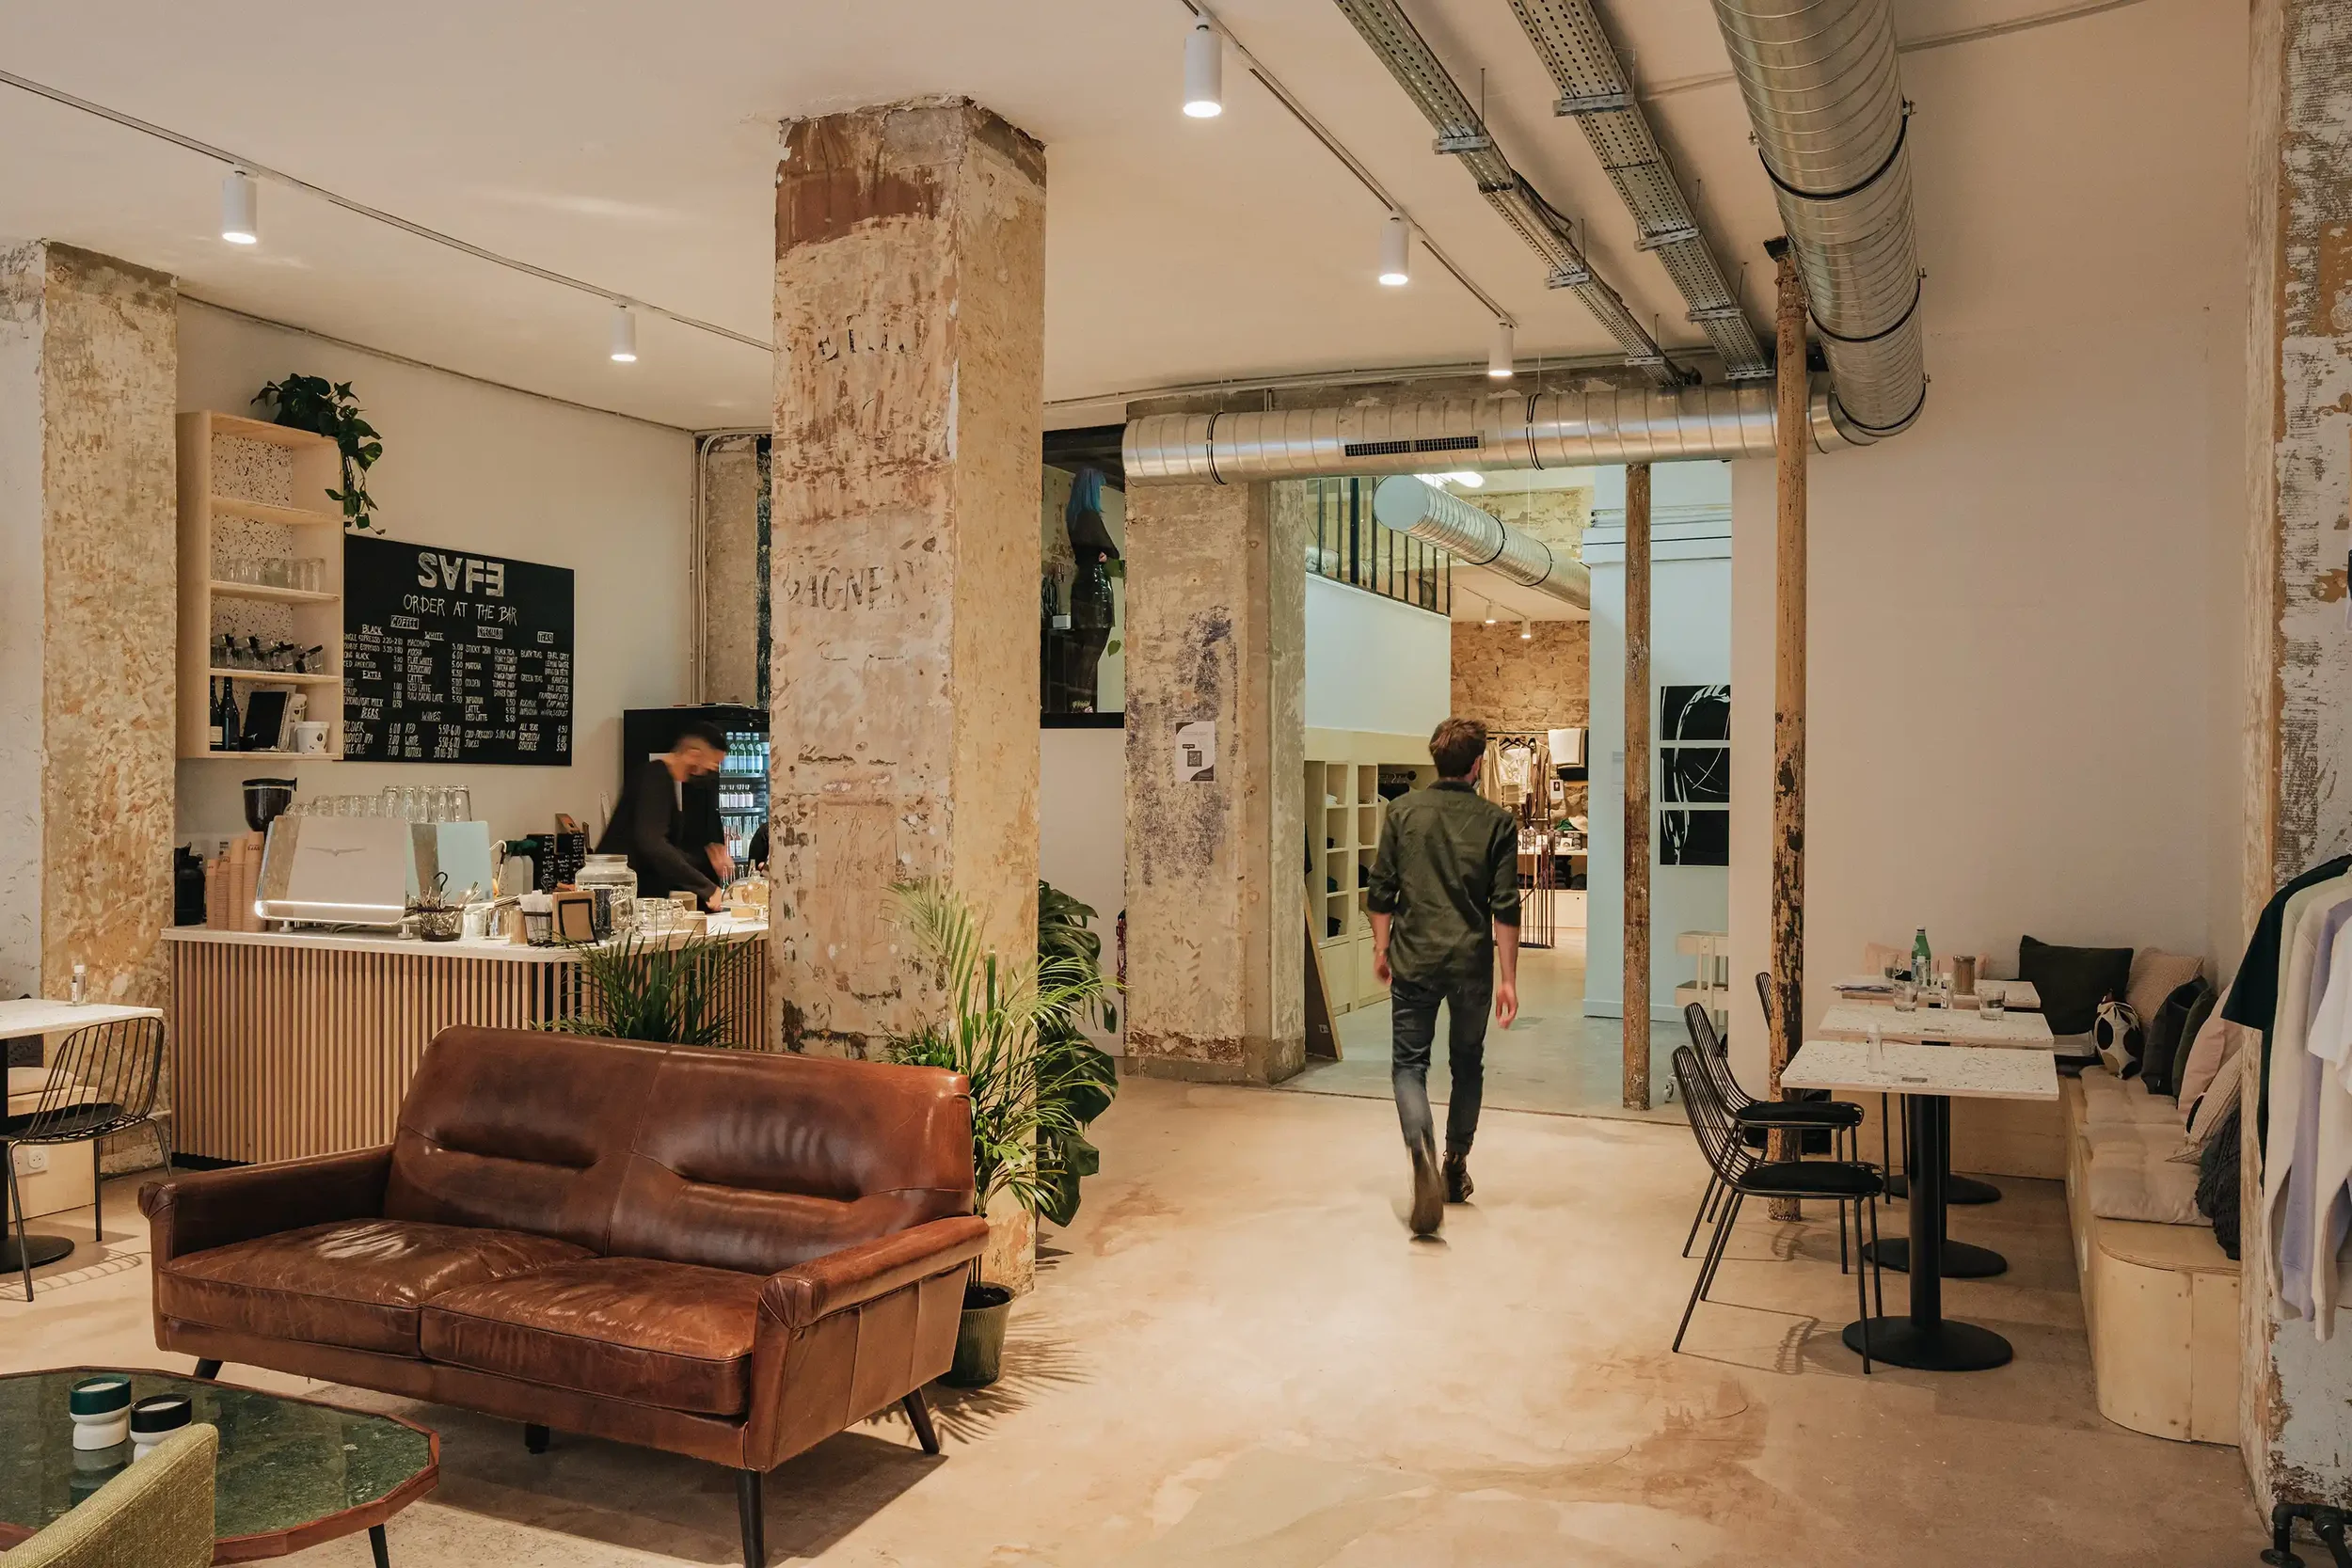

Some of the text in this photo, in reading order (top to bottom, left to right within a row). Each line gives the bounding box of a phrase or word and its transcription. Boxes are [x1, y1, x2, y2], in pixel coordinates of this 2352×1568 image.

[404, 594, 517, 626] ORDER AT THE BAR
[391, 618, 419, 627] COFFEE
[362, 624, 382, 634] BLACK
[358, 635, 380, 643] ESPRESSO
[360, 643, 379, 652] ESPRESSO
[465, 644, 481, 654] STICKY
[520, 649, 532, 658] BLACK
[420, 657, 432, 666] WHITE
[465, 662, 482, 671] MATCHA
[362, 670, 381, 678] EXTRA
[407, 674, 423, 683] LATTE
[520, 673, 533, 682] GREEN
[407, 683, 418, 691] ICED
[419, 684, 431, 692] LATTE
[407, 692, 417, 701] RAW
[418, 693, 431, 702] CACAO
[432, 693, 443, 703] LATTE
[361, 707, 379, 718] BEERS
[421, 711, 441, 721] WINES
[405, 723, 416, 733] RED
[364, 734, 373, 743] IPA
[356, 744, 365, 754] ALE
